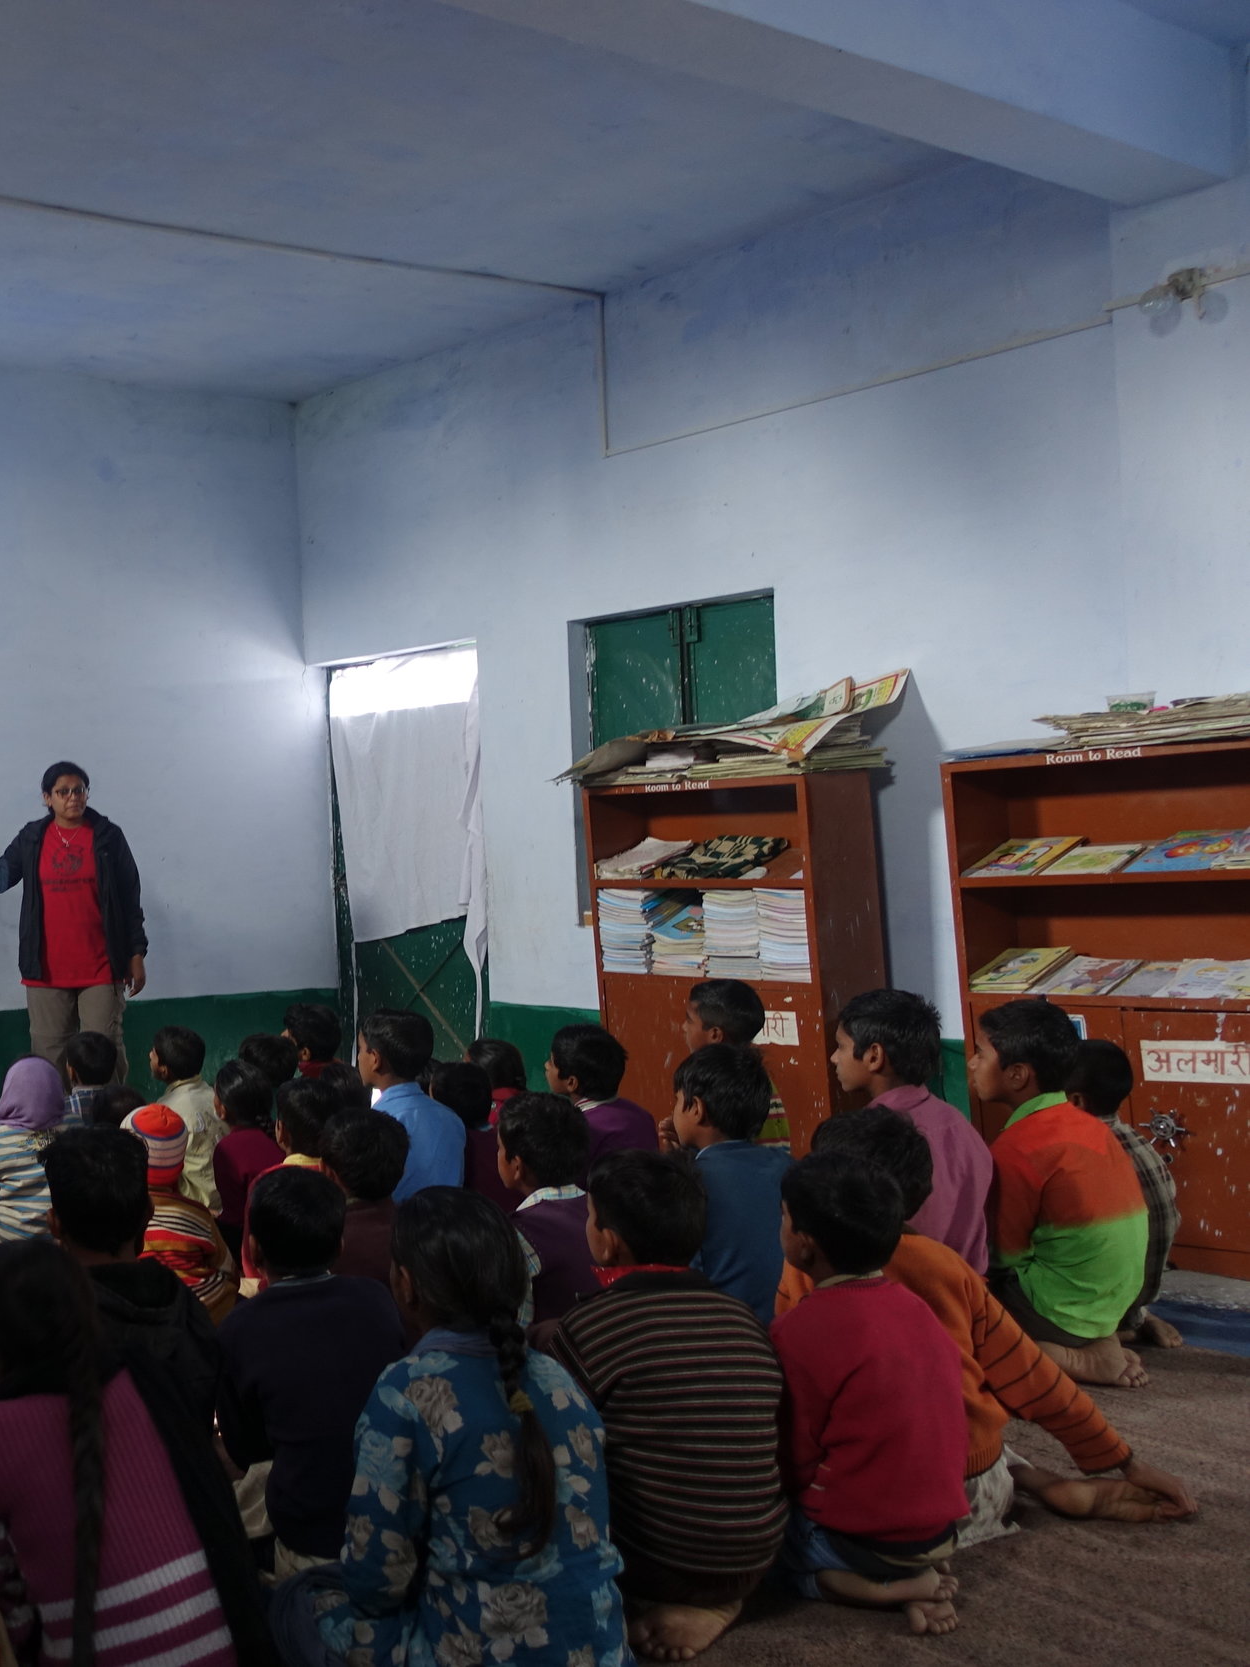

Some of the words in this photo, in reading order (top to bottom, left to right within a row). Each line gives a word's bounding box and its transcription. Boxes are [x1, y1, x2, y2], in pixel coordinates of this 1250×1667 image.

[1046, 752, 1083, 765] Room
[1089, 750, 1101, 761] to
[1106, 747, 1141, 760] Read
[645, 784, 669, 793] Room
[672, 783, 680, 791] to
[684, 780, 710, 791] Read
